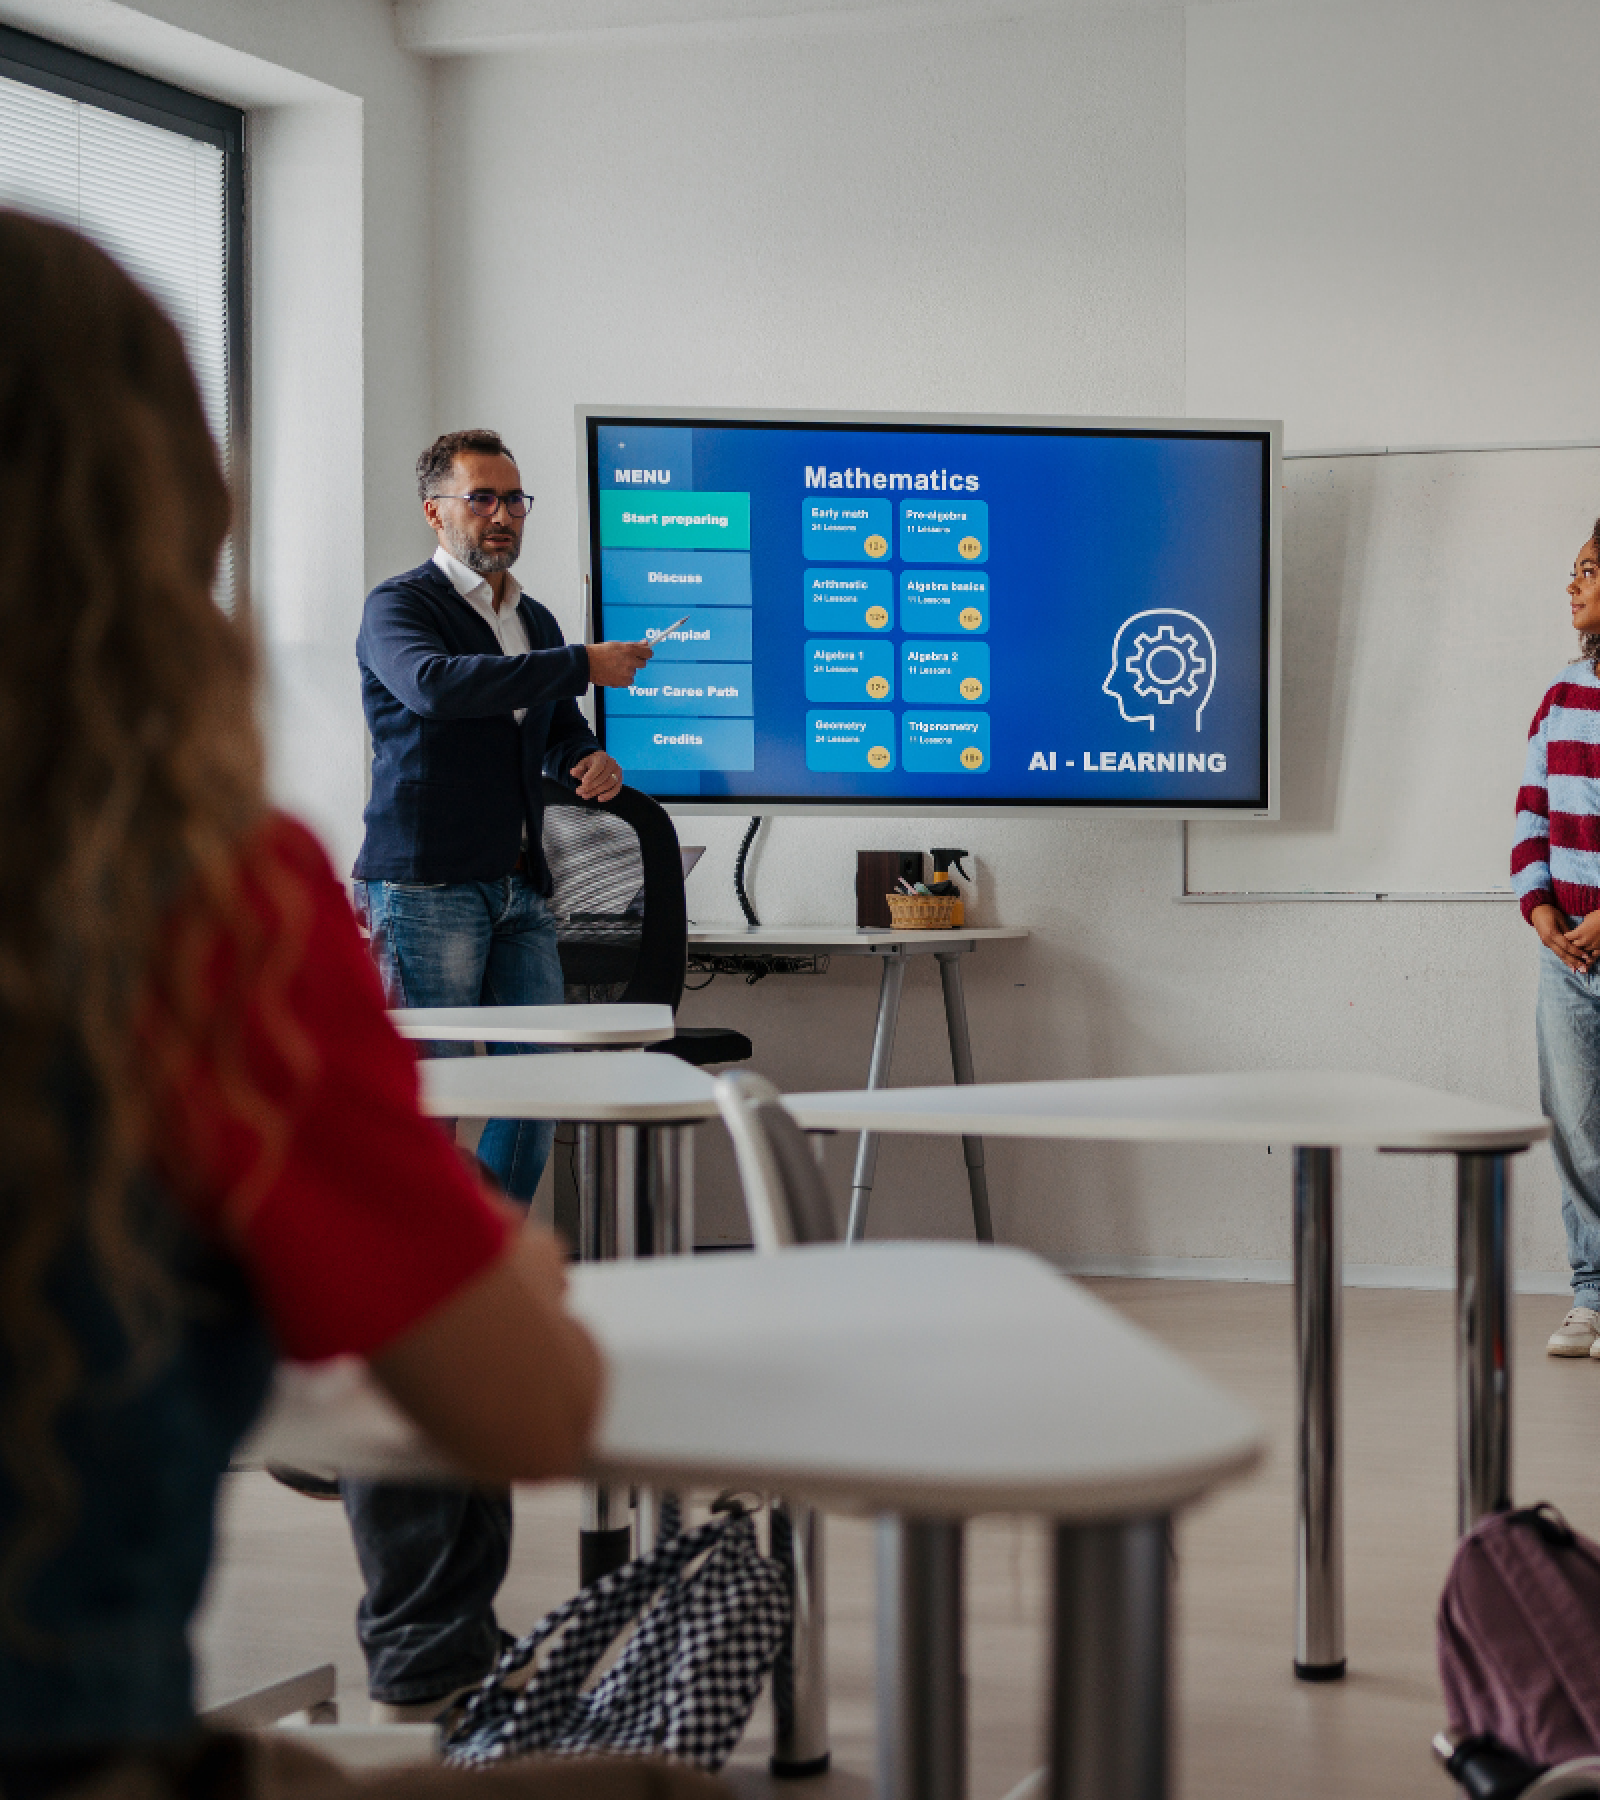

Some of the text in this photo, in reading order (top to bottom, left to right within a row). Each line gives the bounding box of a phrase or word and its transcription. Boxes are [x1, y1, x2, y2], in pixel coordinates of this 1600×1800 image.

[615, 469, 671, 484] MENU
[804, 466, 980, 492] Mathematics
[621, 512, 729, 528] Start preparing
[811, 507, 869, 520] Early math
[905, 509, 967, 522] Pre-algebra
[647, 571, 703, 584] Discuss
[811, 579, 869, 590] Arithmetic
[907, 580, 986, 592] Algebra basics
[813, 649, 864, 662] Algebra 1
[907, 650, 959, 663] Algebra 2
[627, 685, 739, 697] Your Caree Path
[815, 719, 867, 732] Geometry
[908, 721, 979, 733] Trigonometry
[653, 733, 703, 745] Credits
[1027, 751, 1057, 771] AI
[1083, 751, 1227, 773] LEARNING
